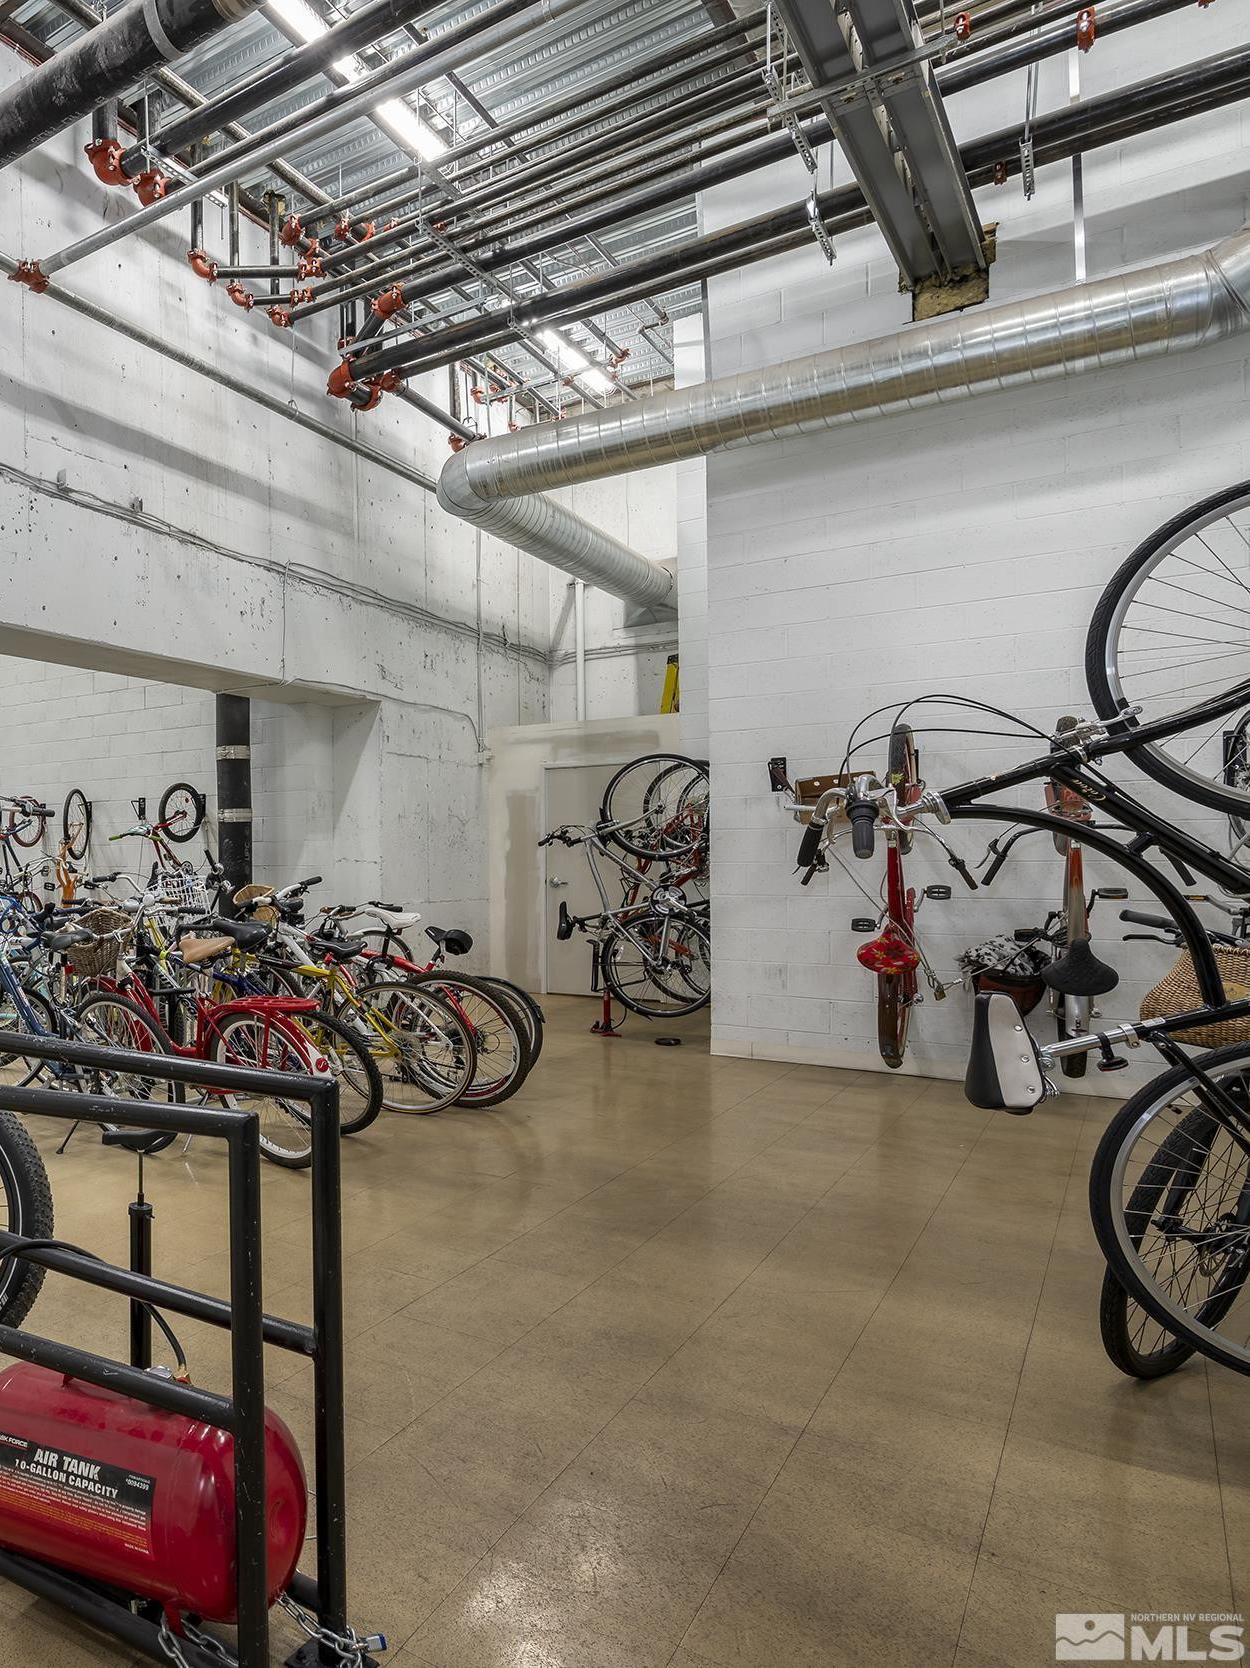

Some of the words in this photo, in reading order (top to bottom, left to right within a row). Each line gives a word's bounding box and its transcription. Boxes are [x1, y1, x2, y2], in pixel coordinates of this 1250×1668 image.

[8, 1437, 28, 1448] FORCE
[15, 1459, 67, 1483] 10-GALLON
[68, 1475, 119, 1499] CAPACITY
[33, 1448, 59, 1468] AIR
[62, 1455, 101, 1481] TANK
